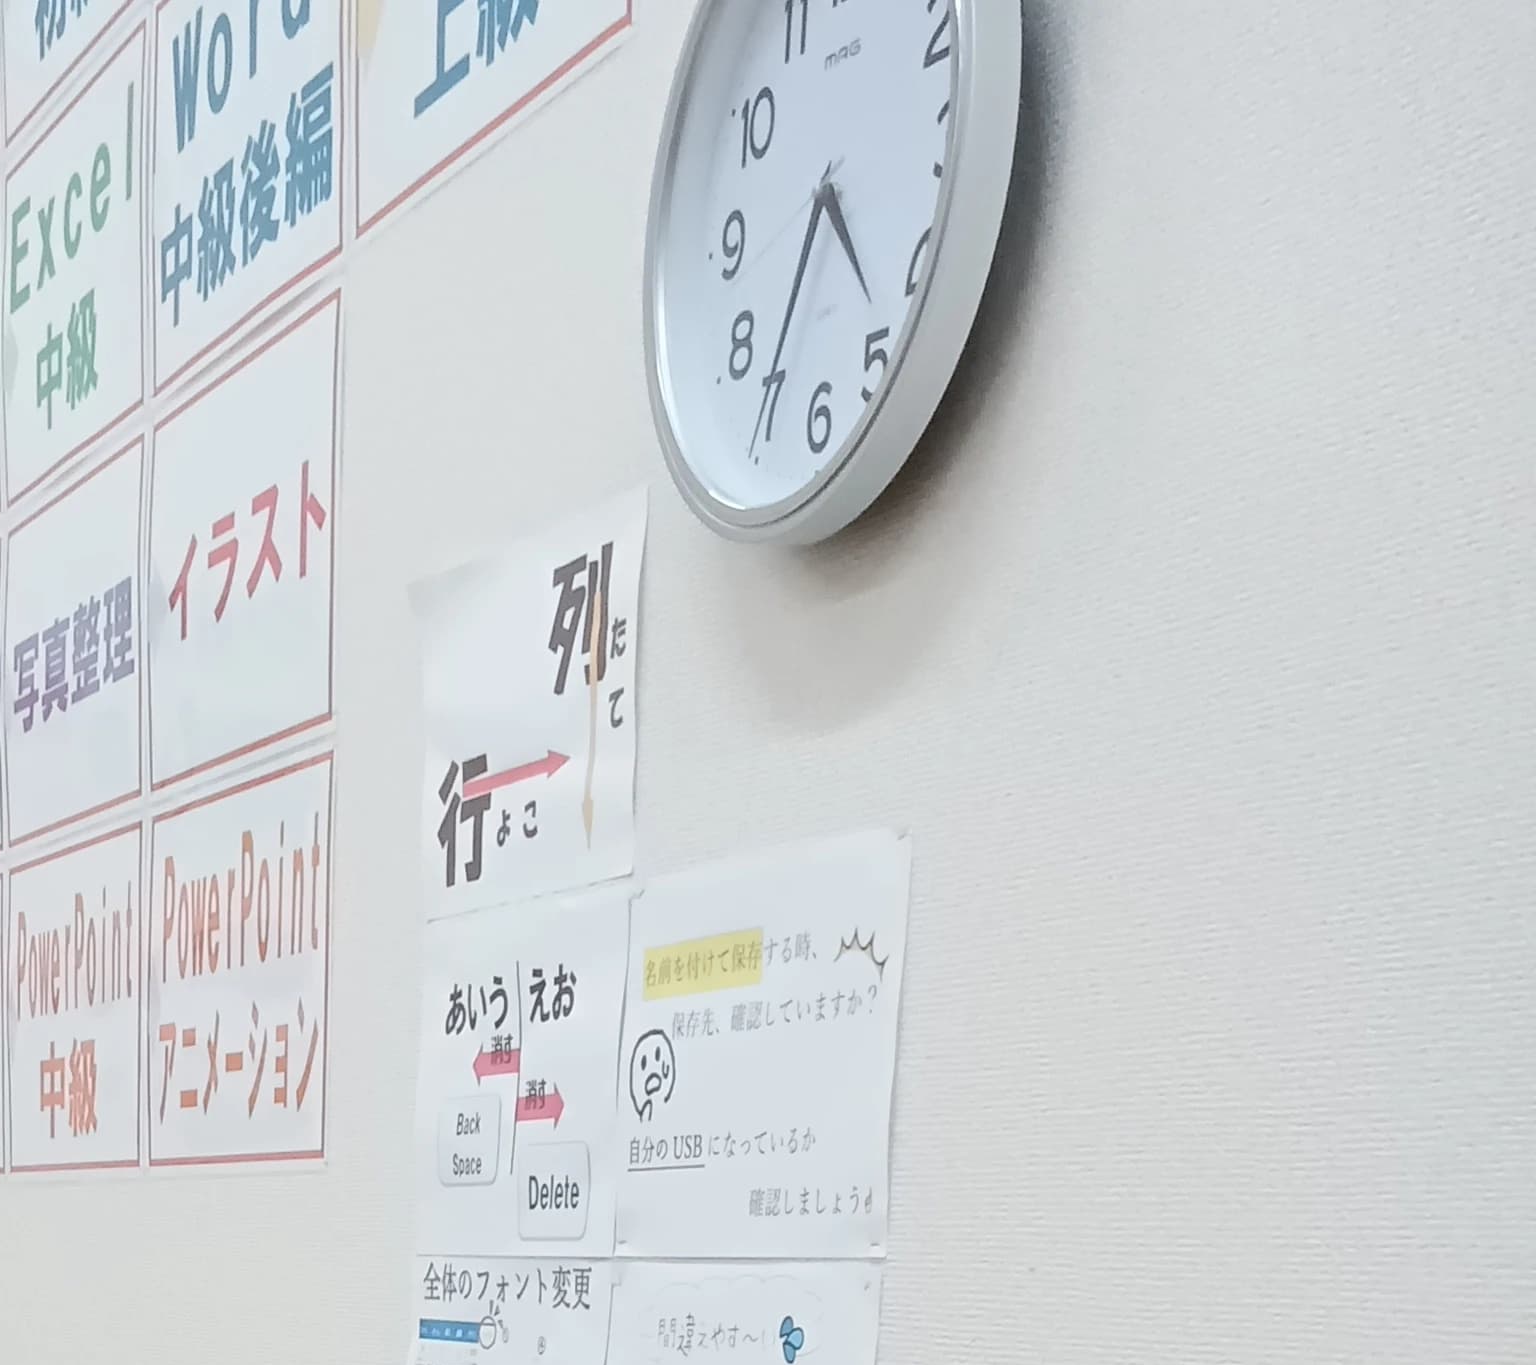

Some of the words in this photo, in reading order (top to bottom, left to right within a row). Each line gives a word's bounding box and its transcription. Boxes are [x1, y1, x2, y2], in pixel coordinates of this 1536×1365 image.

[741, 86, 776, 168] 10
[11, 80, 135, 315] Excel
[161, 61, 335, 328] 中級後編
[721, 209, 746, 281] 9
[36, 286, 100, 431] 中級
[728, 309, 755, 381] 8
[860, 325, 891, 402] 5
[762, 369, 787, 442] 7
[806, 380, 833, 454] 6
[168, 459, 328, 641] イラスト
[12, 575, 136, 733] 写真整理
[547, 540, 614, 695] 列
[608, 616, 627, 729] たて
[437, 752, 493, 888] 行
[495, 800, 538, 847] よこ
[164, 811, 321, 984] PowerPoint
[16, 881, 133, 1022] PowerPoint
[444, 975, 510, 1036] あいう
[527, 962, 577, 1025] えお
[158, 997, 320, 1126] アニメーション
[490, 1033, 515, 1065] 消す
[39, 1038, 99, 1140] 中級
[455, 1111, 481, 1136] Back
[524, 1078, 547, 1111] 消す
[451, 1153, 483, 1177] Space
[672, 1134, 704, 1161] USB
[527, 1174, 581, 1212] Delete
[422, 1260, 594, 1311] 全体のフォント変更
